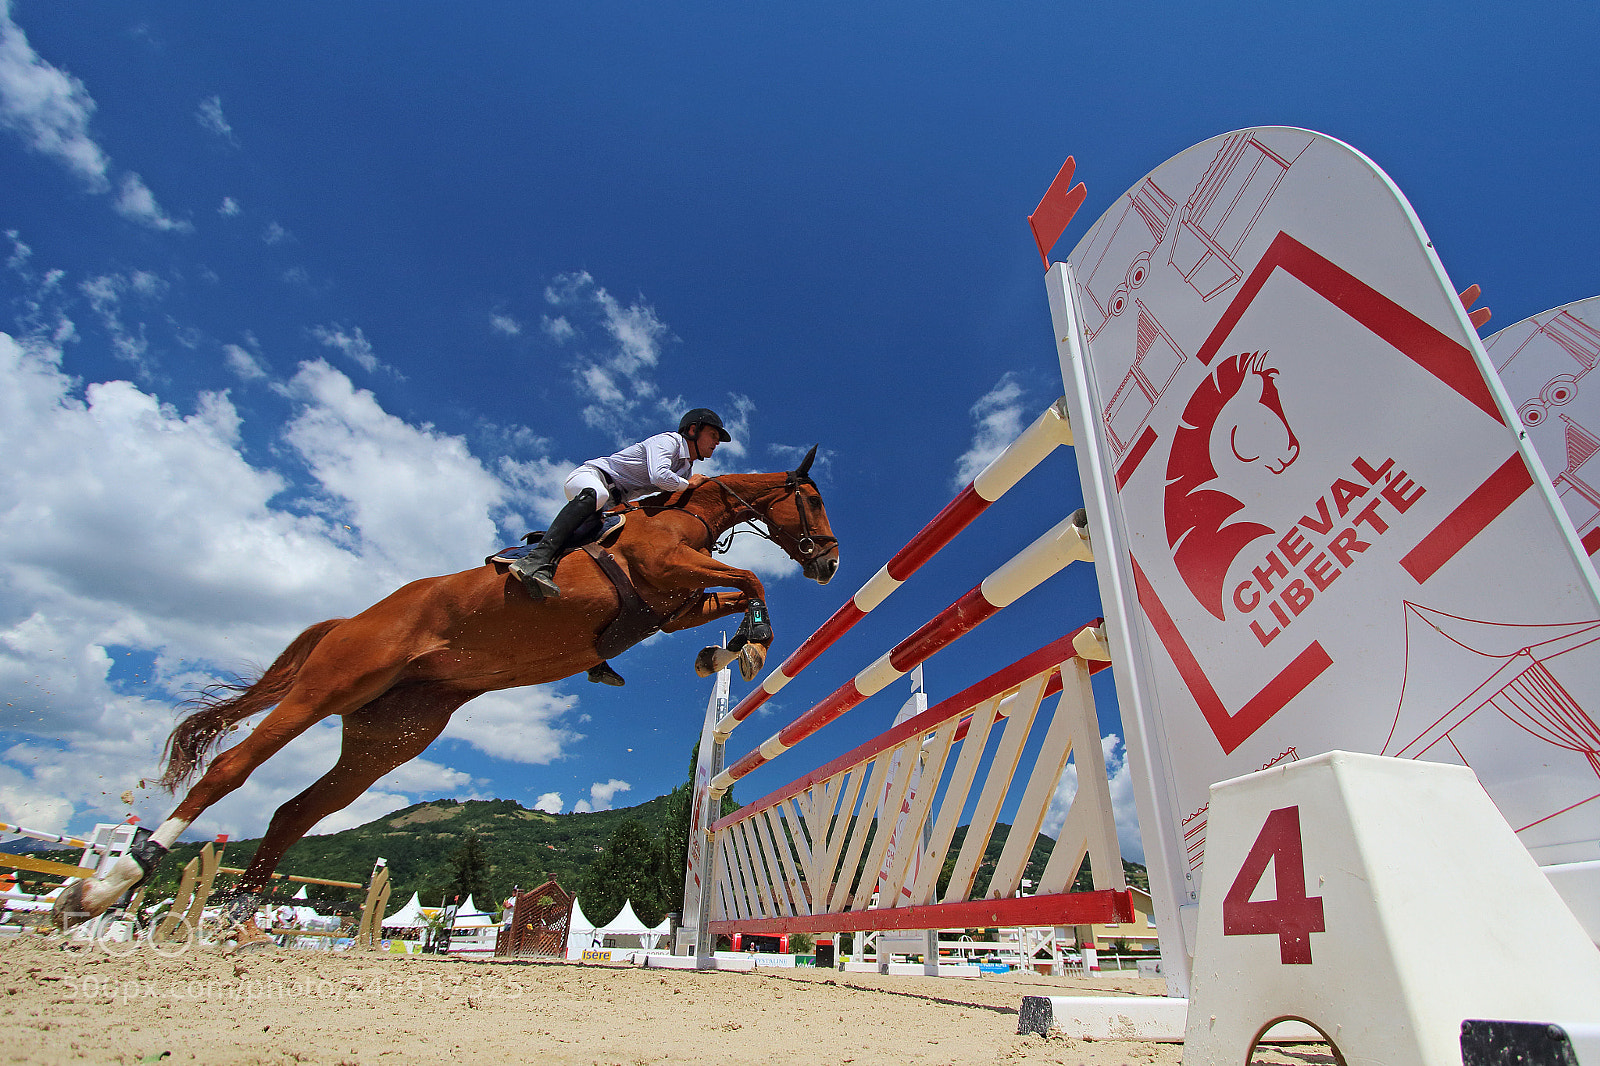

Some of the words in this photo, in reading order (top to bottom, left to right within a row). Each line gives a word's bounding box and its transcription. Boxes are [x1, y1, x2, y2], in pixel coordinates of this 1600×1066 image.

[1233, 456, 1396, 614] CHEVAL
[1249, 470, 1427, 648] LIBERTÉ
[582, 949, 611, 960] isère
[1222, 805, 1326, 965] 4
